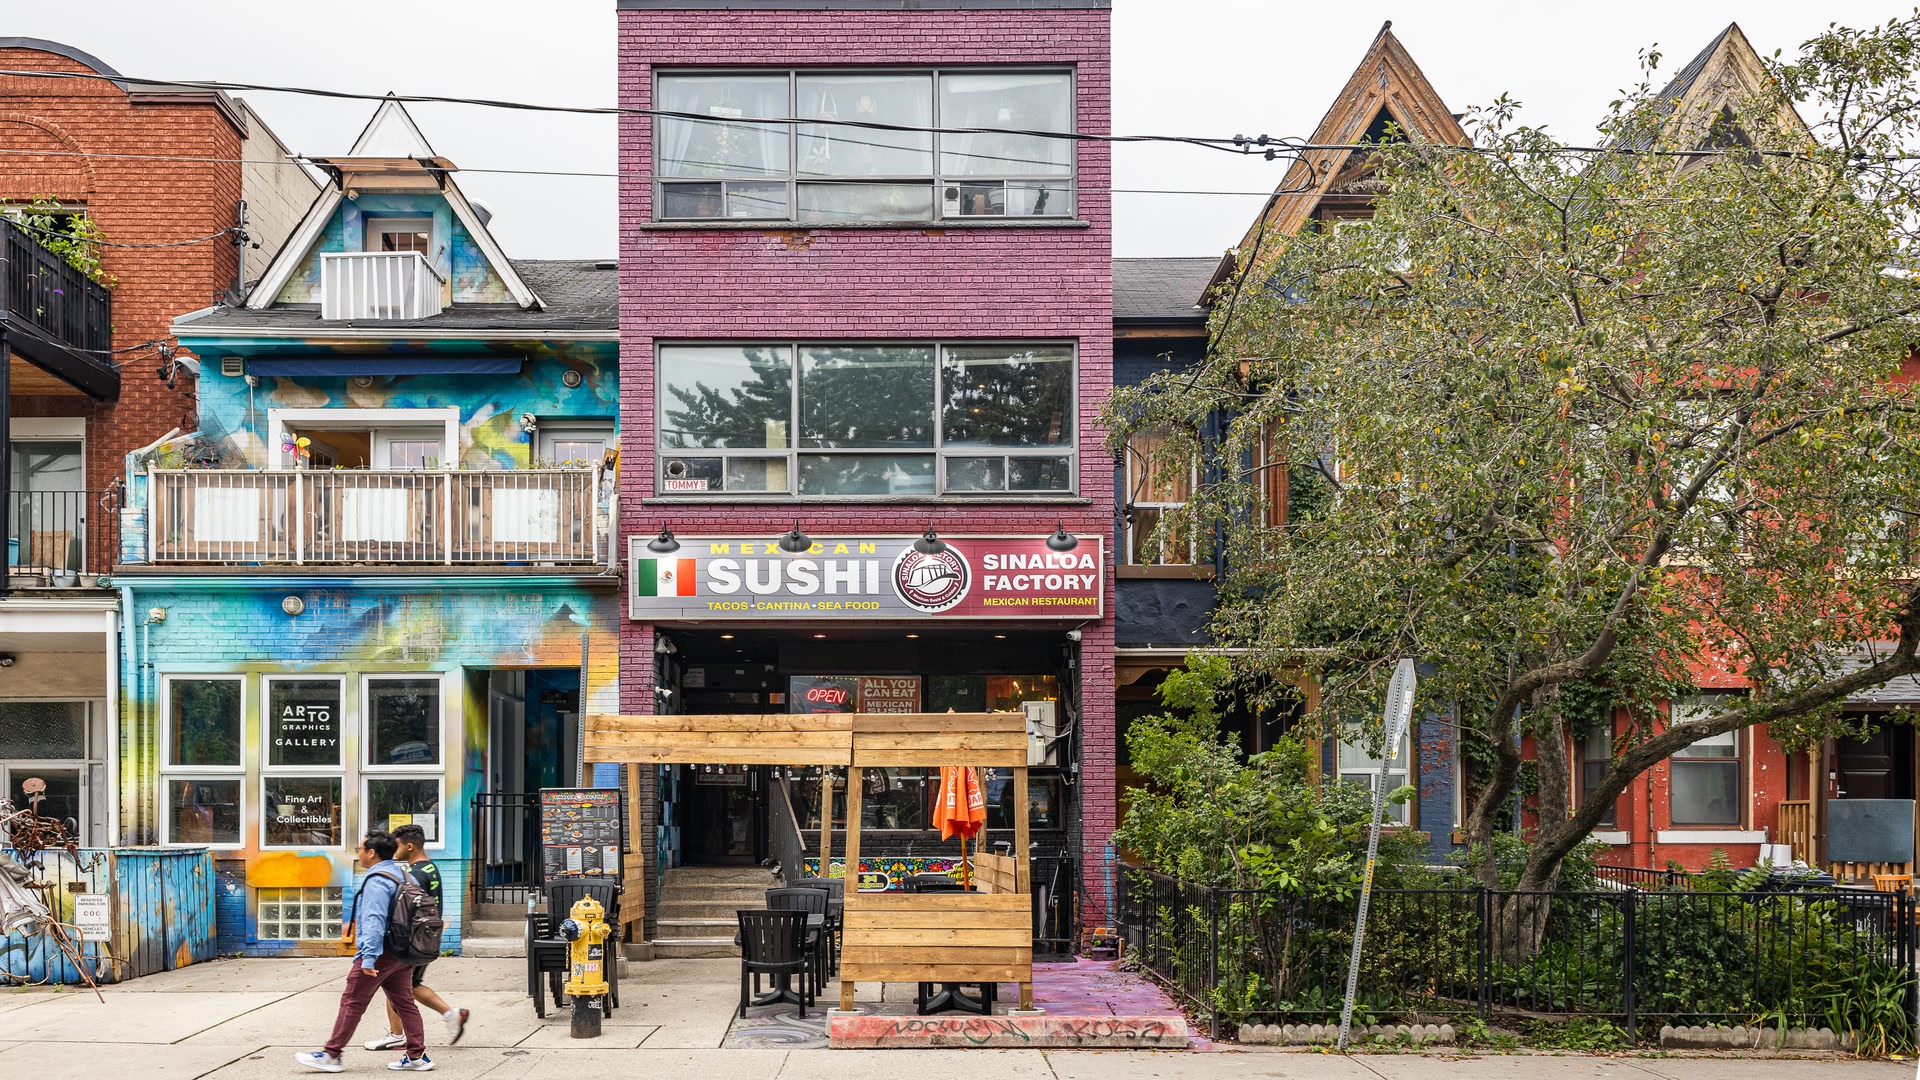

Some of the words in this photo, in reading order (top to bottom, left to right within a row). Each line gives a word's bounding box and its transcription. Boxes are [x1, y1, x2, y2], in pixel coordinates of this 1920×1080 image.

[666, 480, 699, 490] TOMMY
[710, 543, 876, 555] MEXCAN
[983, 553, 1096, 570] SINALOA
[707, 558, 880, 595] SUSHI
[983, 574, 1097, 591] FACTORY
[707, 601, 749, 611] TACOS
[756, 601, 811, 611] CANTINA
[817, 601, 842, 611] SEA
[845, 601, 880, 611] FOOD
[983, 597, 1029, 606] MEXICAN
[1031, 597, 1098, 606] RESTAURANT
[864, 680, 888, 689] ALL
[890, 680, 916, 689] YOU
[806, 688, 847, 704] OPEN
[864, 689, 890, 698] CAN
[892, 689, 916, 698] EAT
[275, 738, 336, 747] GALLERY
[285, 795, 306, 804] Fine
[307, 795, 323, 804] Art
[300, 805, 309, 814] &
[276, 815, 332, 824] Collectibles
